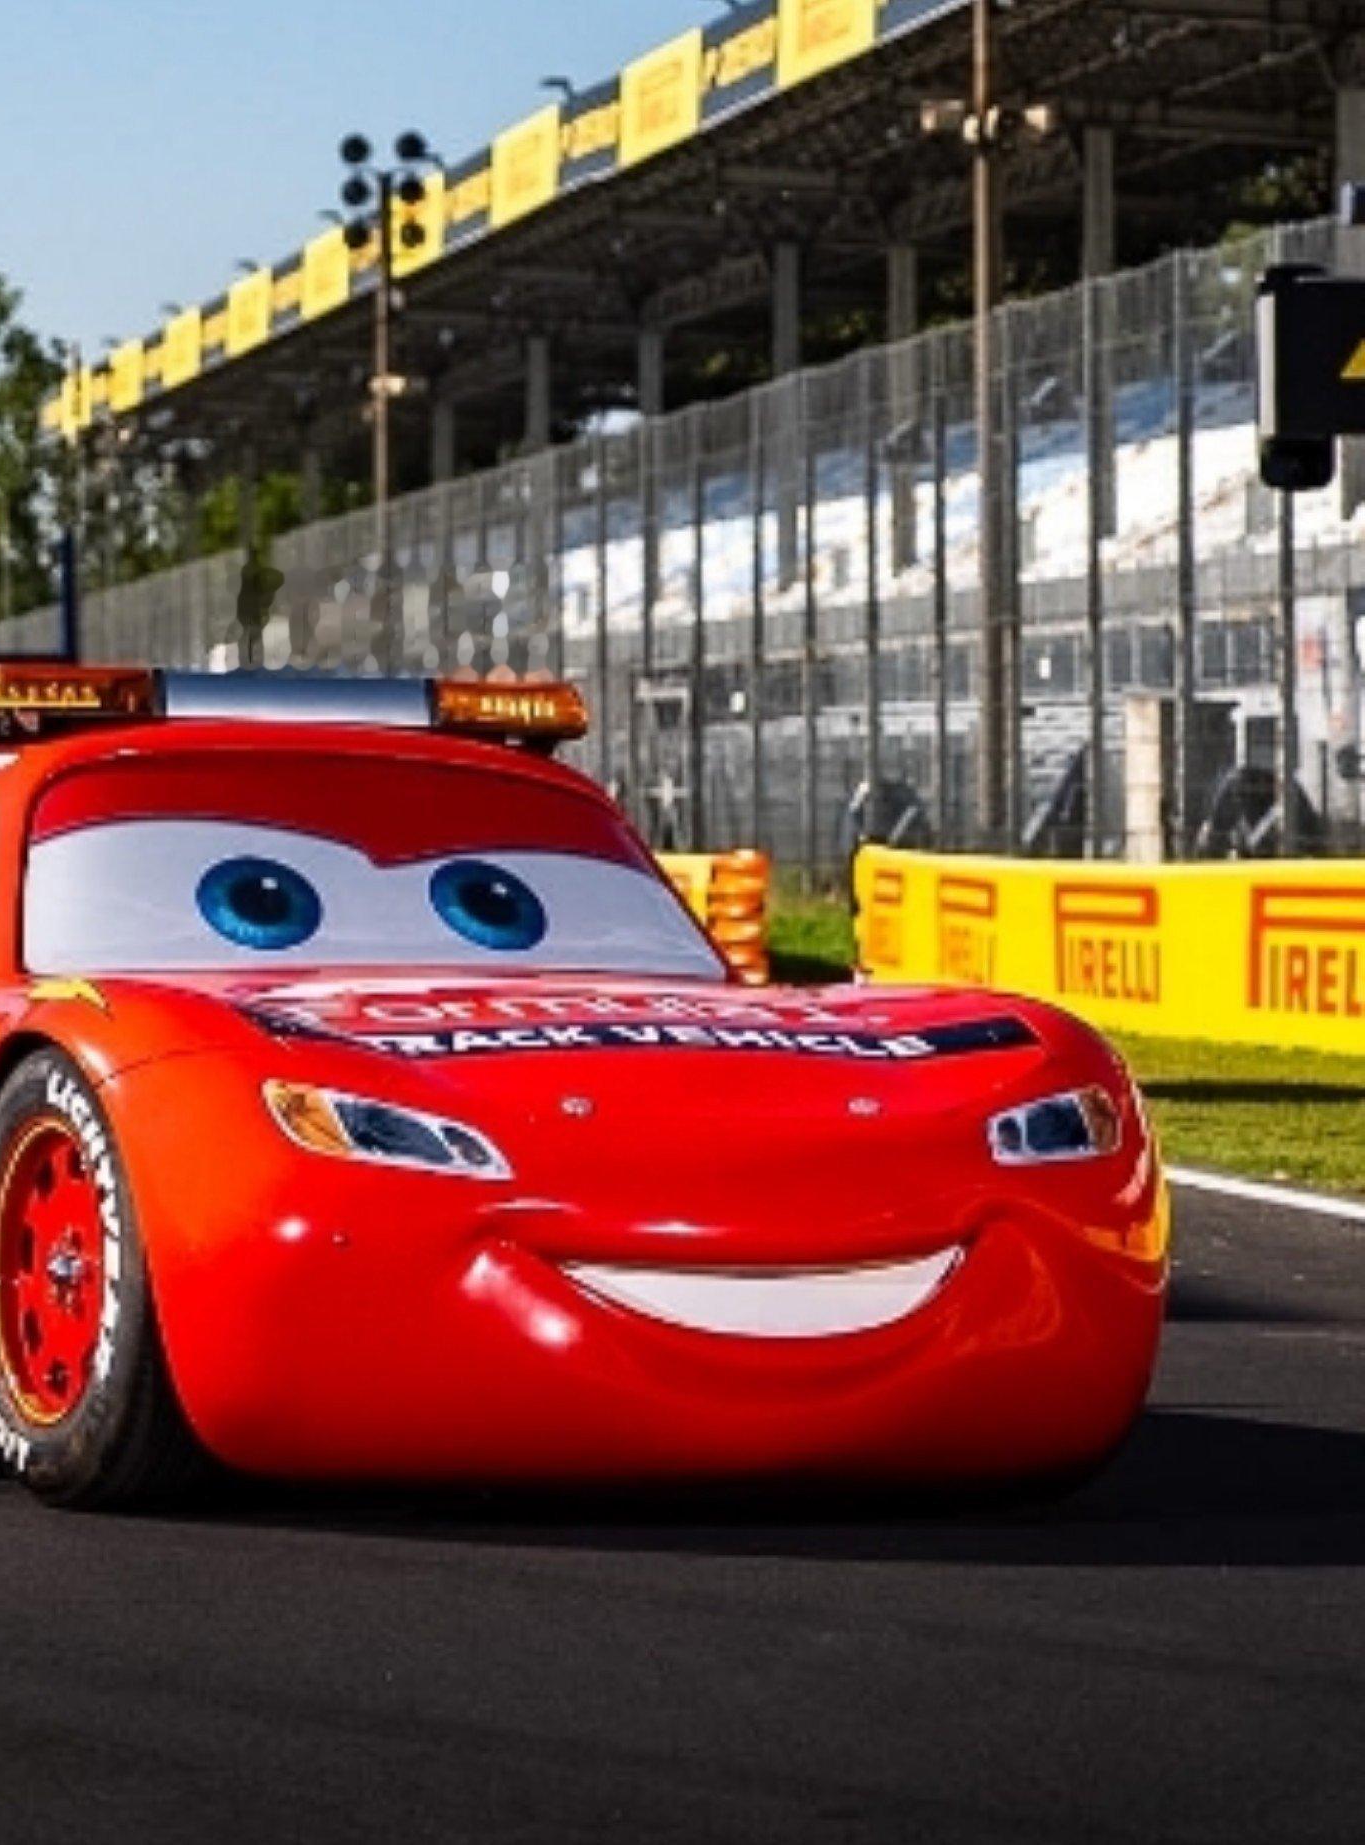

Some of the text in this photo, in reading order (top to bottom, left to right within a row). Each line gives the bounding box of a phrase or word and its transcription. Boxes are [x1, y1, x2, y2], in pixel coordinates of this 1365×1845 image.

[1053, 882, 1161, 1004] PIRELLI
[356, 1024, 936, 1058] TRACK VEHICLE
